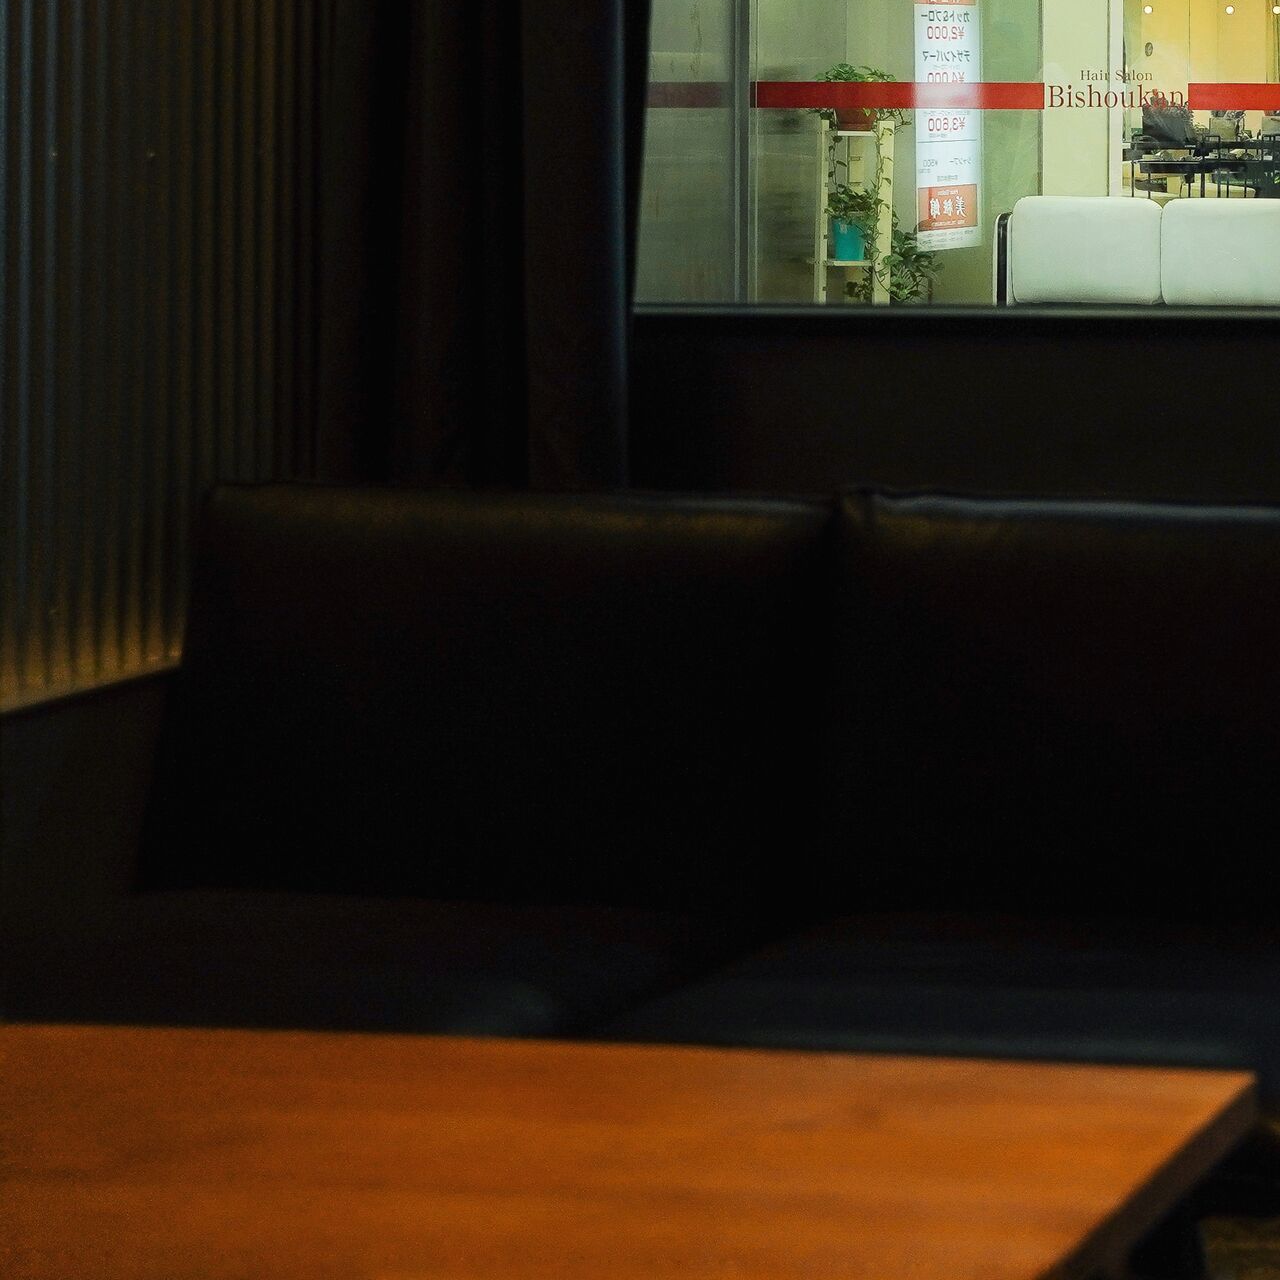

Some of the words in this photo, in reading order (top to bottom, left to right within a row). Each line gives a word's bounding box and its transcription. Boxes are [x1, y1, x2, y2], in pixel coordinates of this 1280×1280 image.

[1080, 70, 1109, 81] Hair
[1115, 70, 1153, 81] Salon
[1048, 84, 1184, 108] Bishoukan
